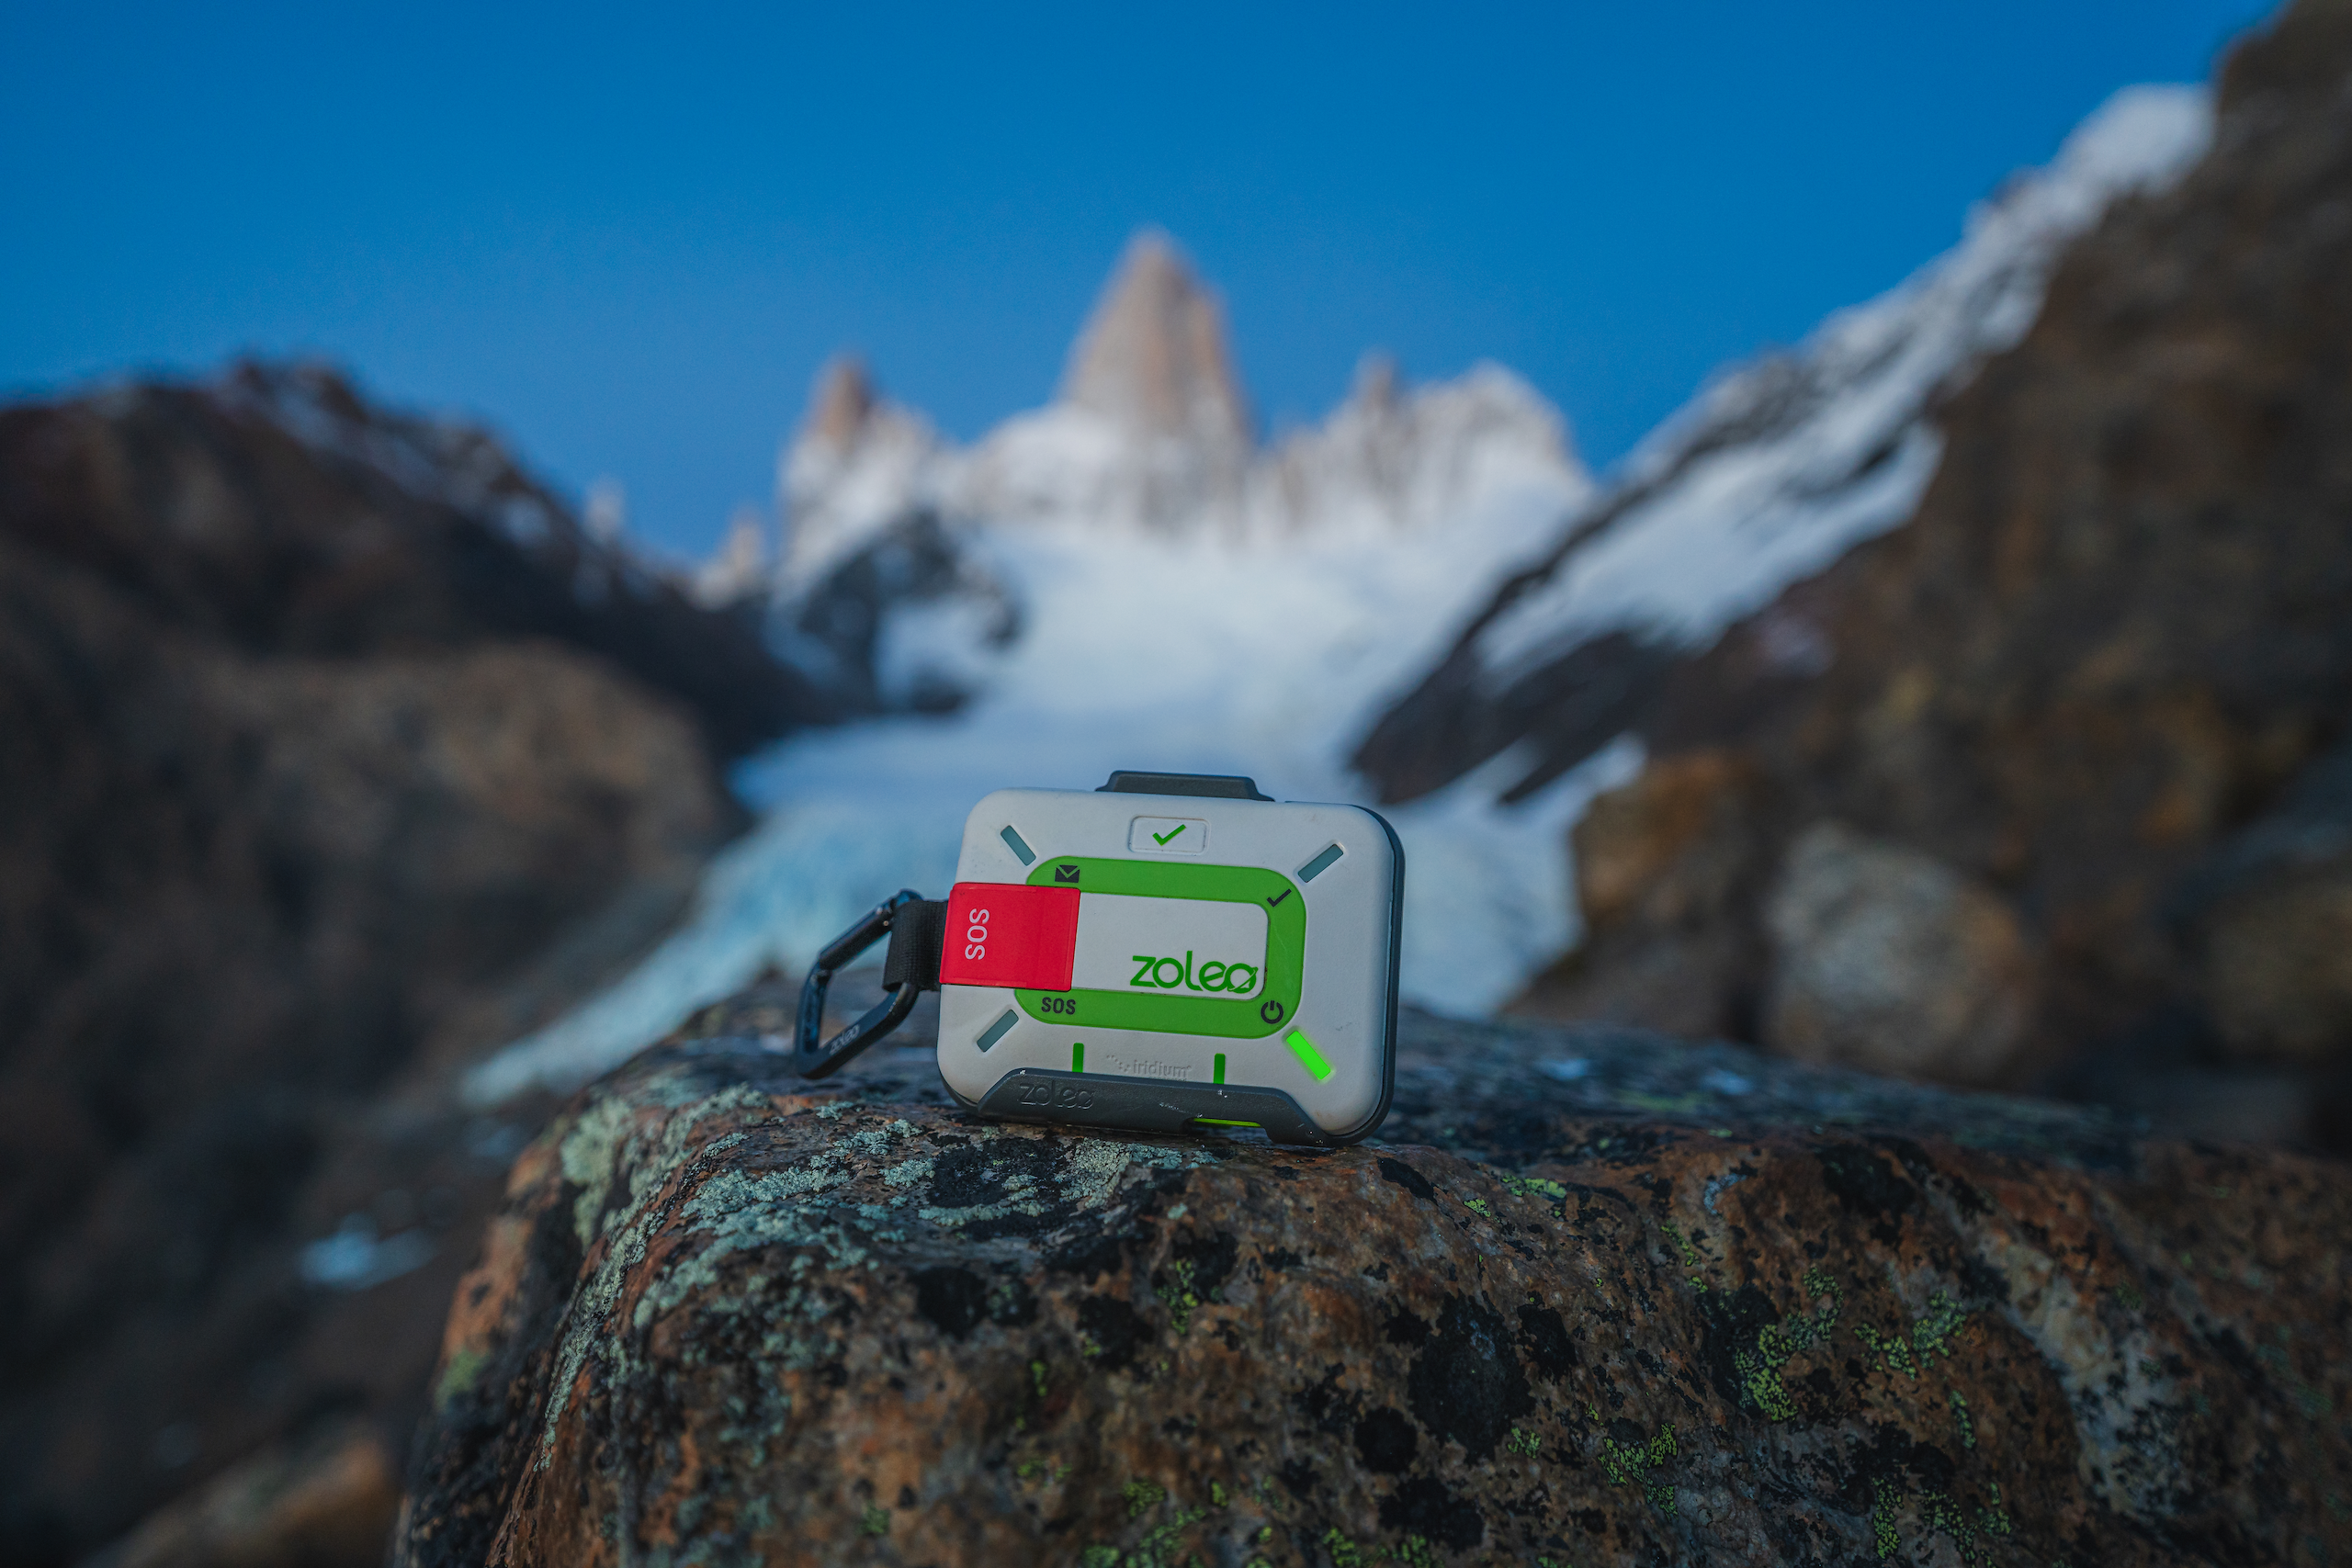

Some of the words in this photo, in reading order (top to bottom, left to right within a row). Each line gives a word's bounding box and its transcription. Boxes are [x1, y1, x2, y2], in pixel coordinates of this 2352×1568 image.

[965, 908, 989, 960] SOS
[1041, 997, 1076, 1015] SOS
[1133, 1059, 1189, 1077] iridium
